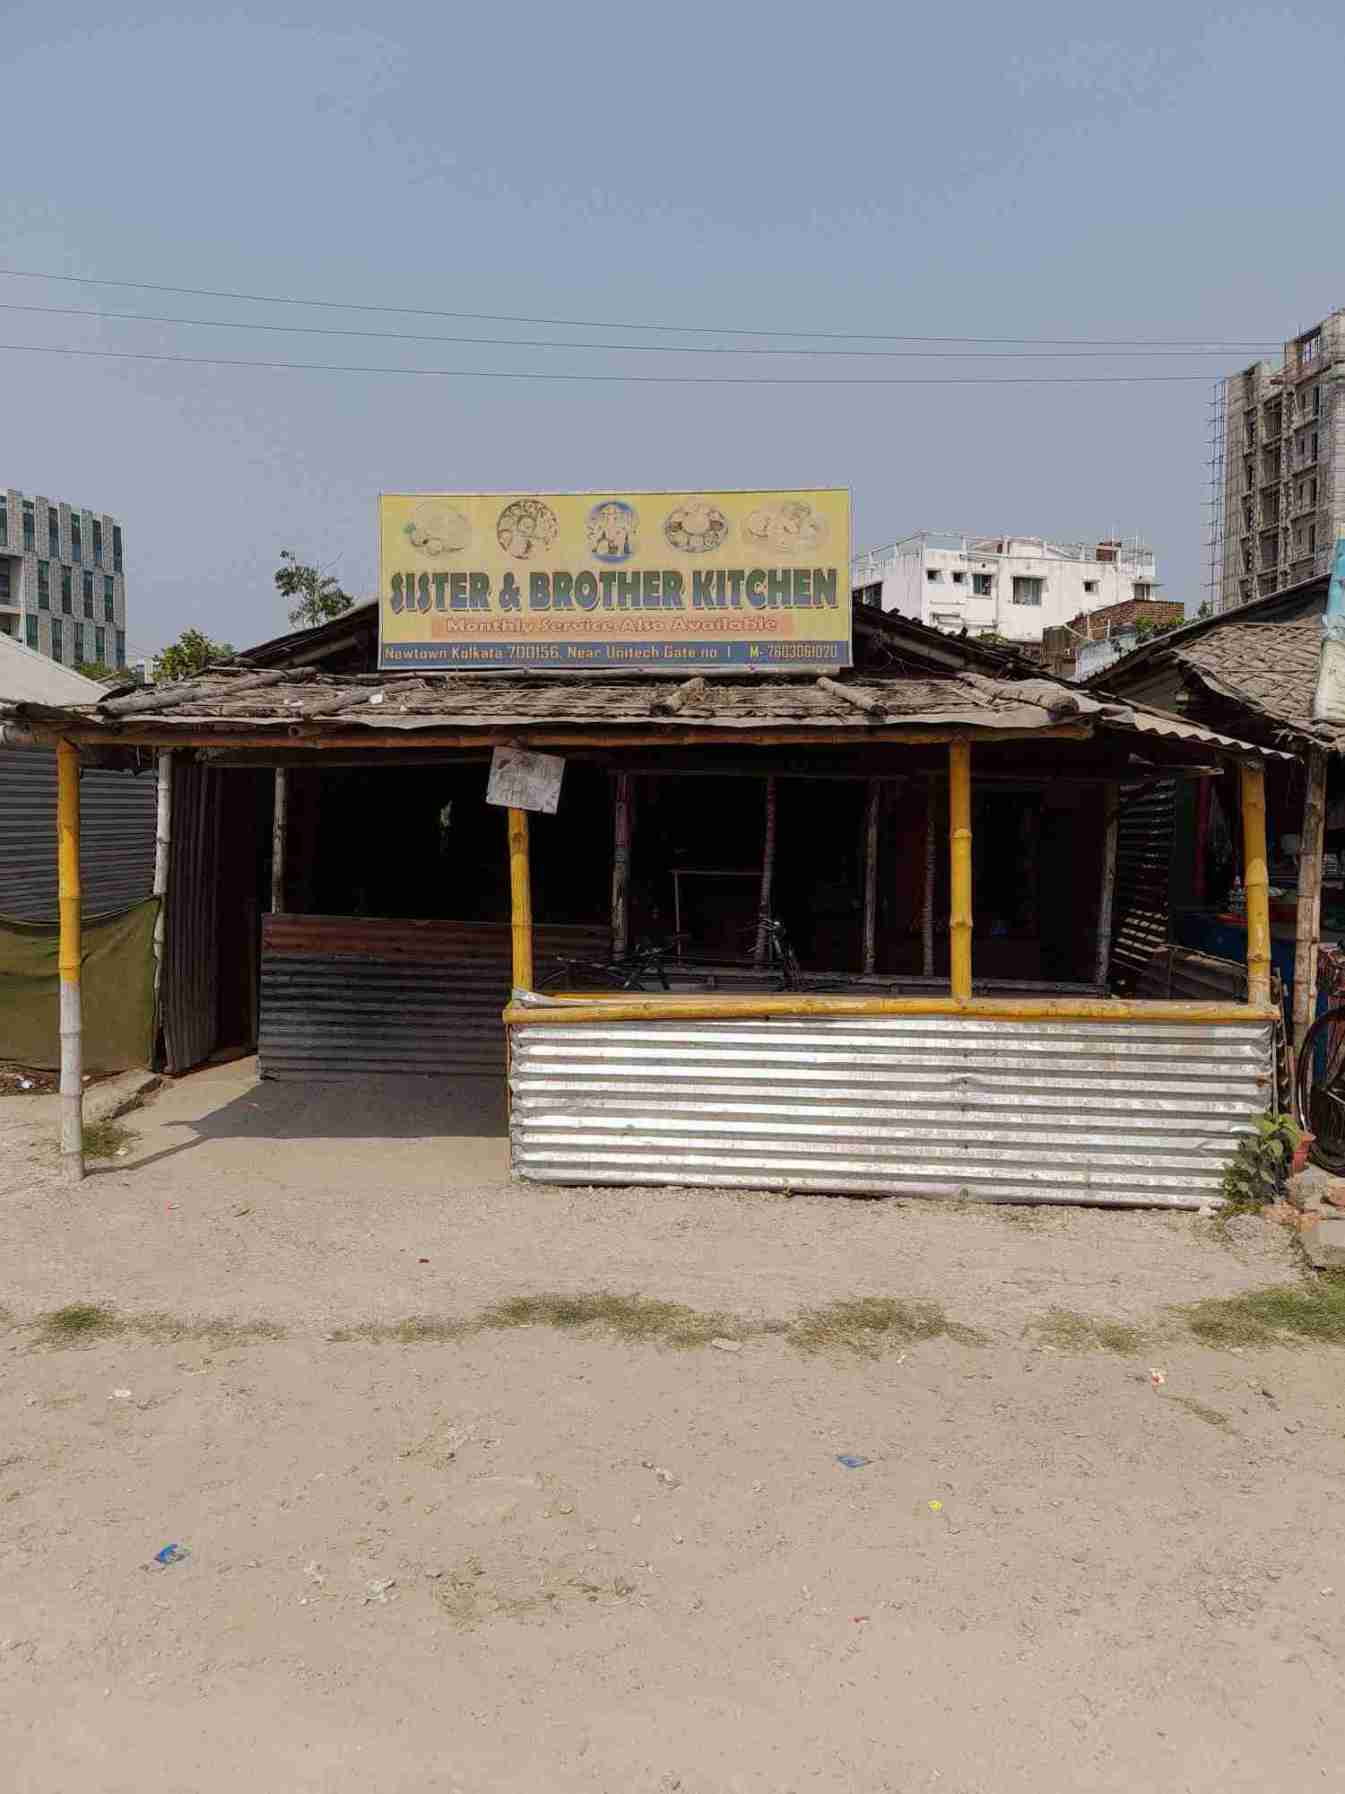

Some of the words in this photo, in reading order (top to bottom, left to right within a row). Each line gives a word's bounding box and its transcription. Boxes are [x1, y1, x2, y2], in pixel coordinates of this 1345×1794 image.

[391, 571, 493, 614] SISTER
[499, 571, 522, 612] &
[528, 570, 687, 612] BROTHER
[691, 568, 839, 610] KITCHEN
[446, 618, 533, 634] Monthly
[540, 617, 616, 633] Service
[671, 615, 777, 633] Available
